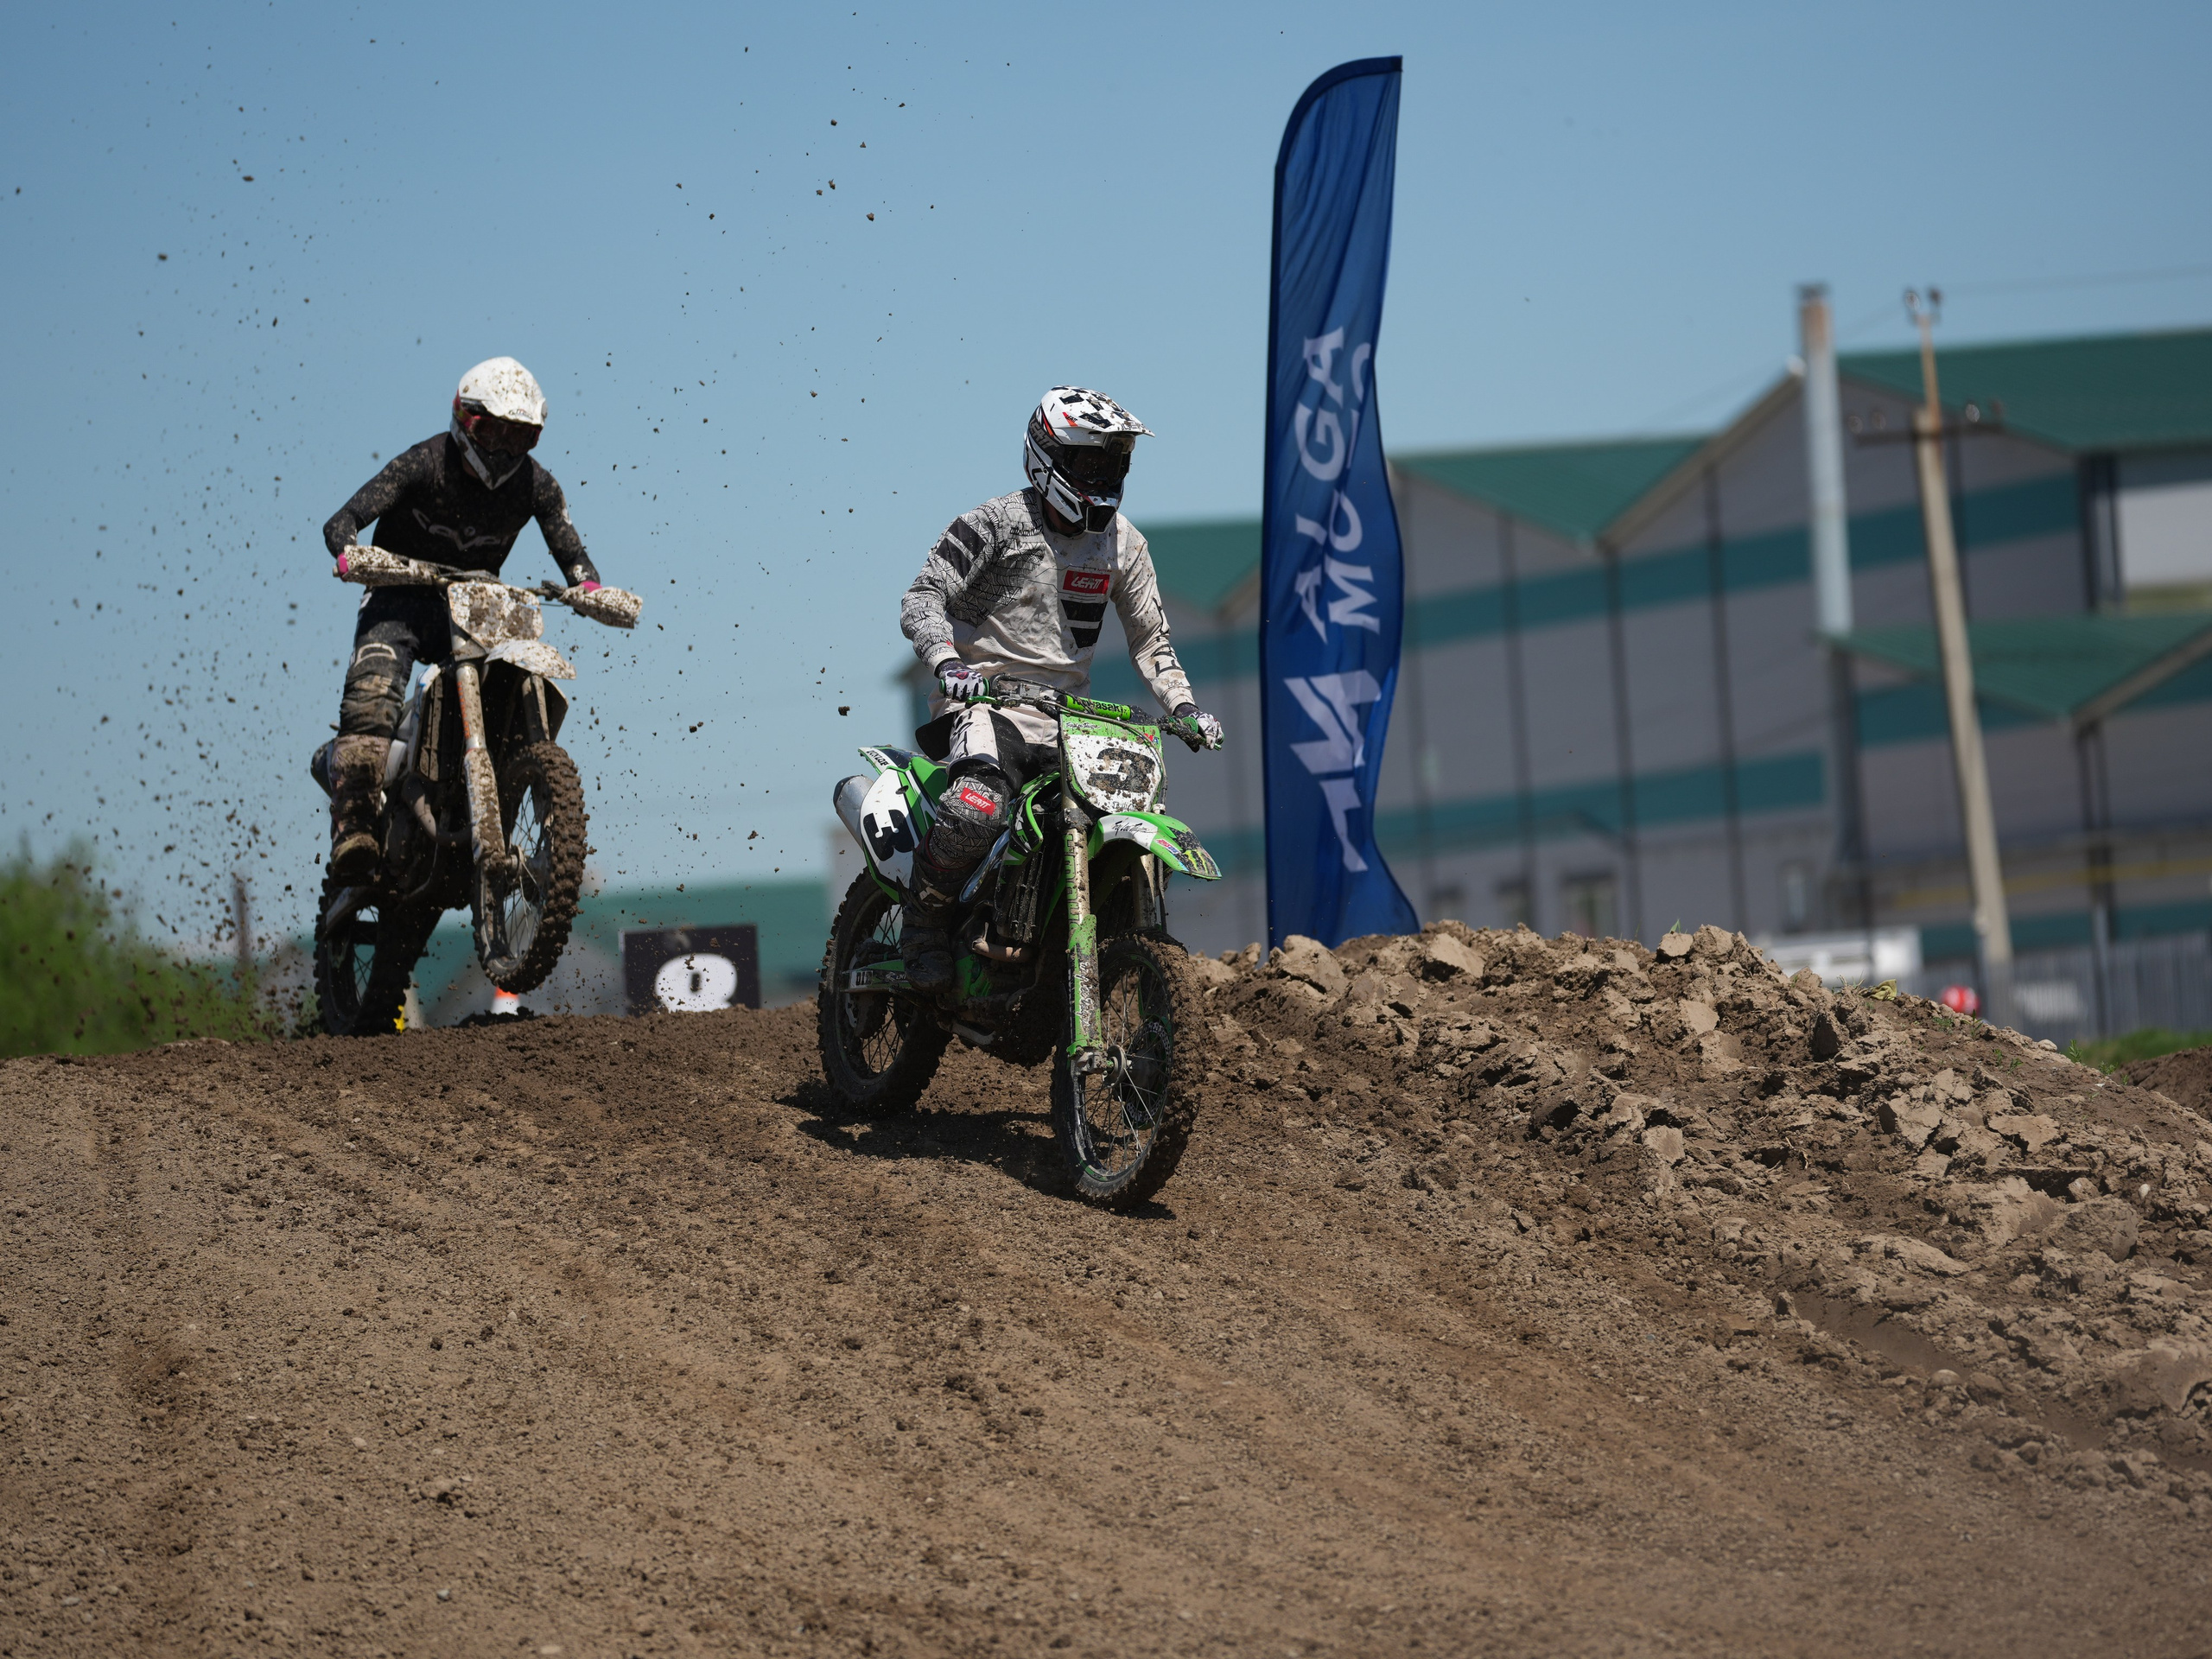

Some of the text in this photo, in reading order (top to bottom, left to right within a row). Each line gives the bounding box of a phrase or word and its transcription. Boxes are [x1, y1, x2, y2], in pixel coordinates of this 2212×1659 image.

[1071, 576, 1104, 590] LEATT
[1087, 747, 1156, 794] 3
[965, 792, 991, 809] LEATT
[862, 809, 915, 861] 3
